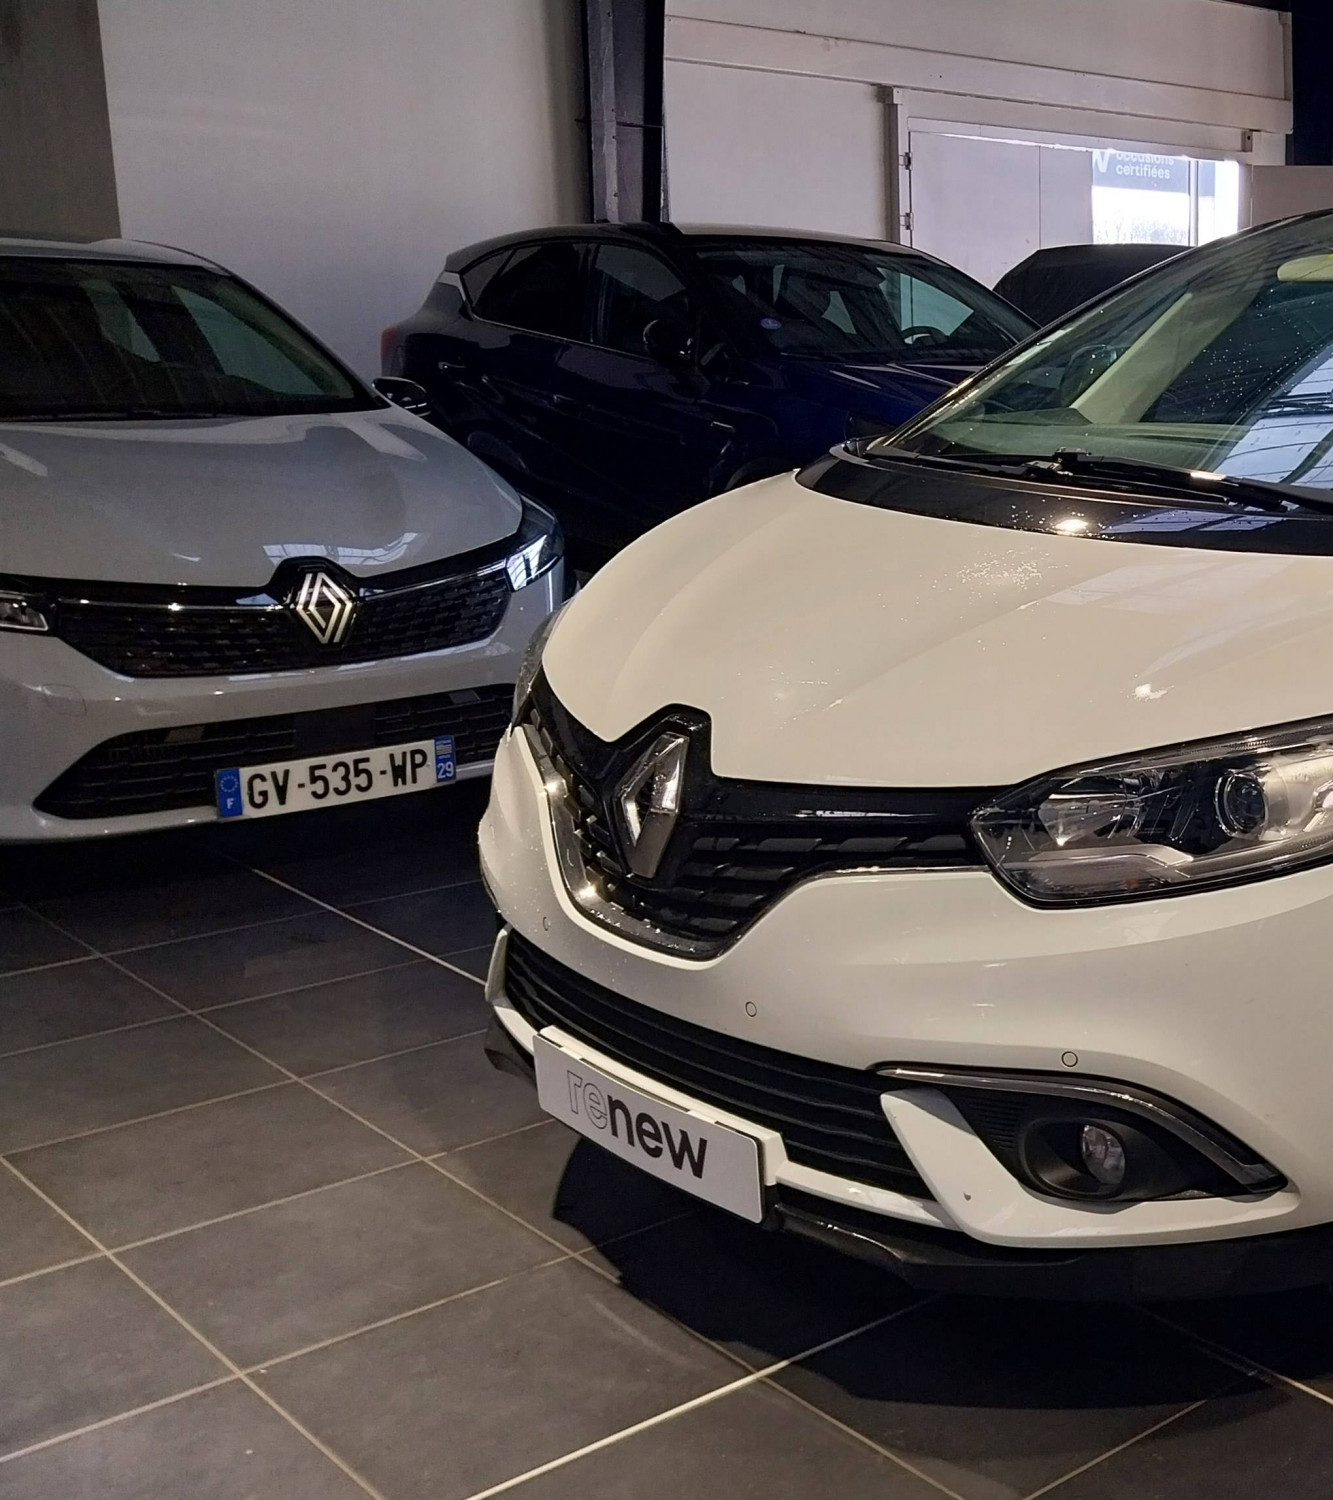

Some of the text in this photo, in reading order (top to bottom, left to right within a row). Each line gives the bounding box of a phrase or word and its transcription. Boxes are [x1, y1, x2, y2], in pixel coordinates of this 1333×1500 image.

[1115, 163, 1171, 179] certifiées
[226, 748, 455, 810] F GV-535-WP 29
[566, 1069, 708, 1180] renew
